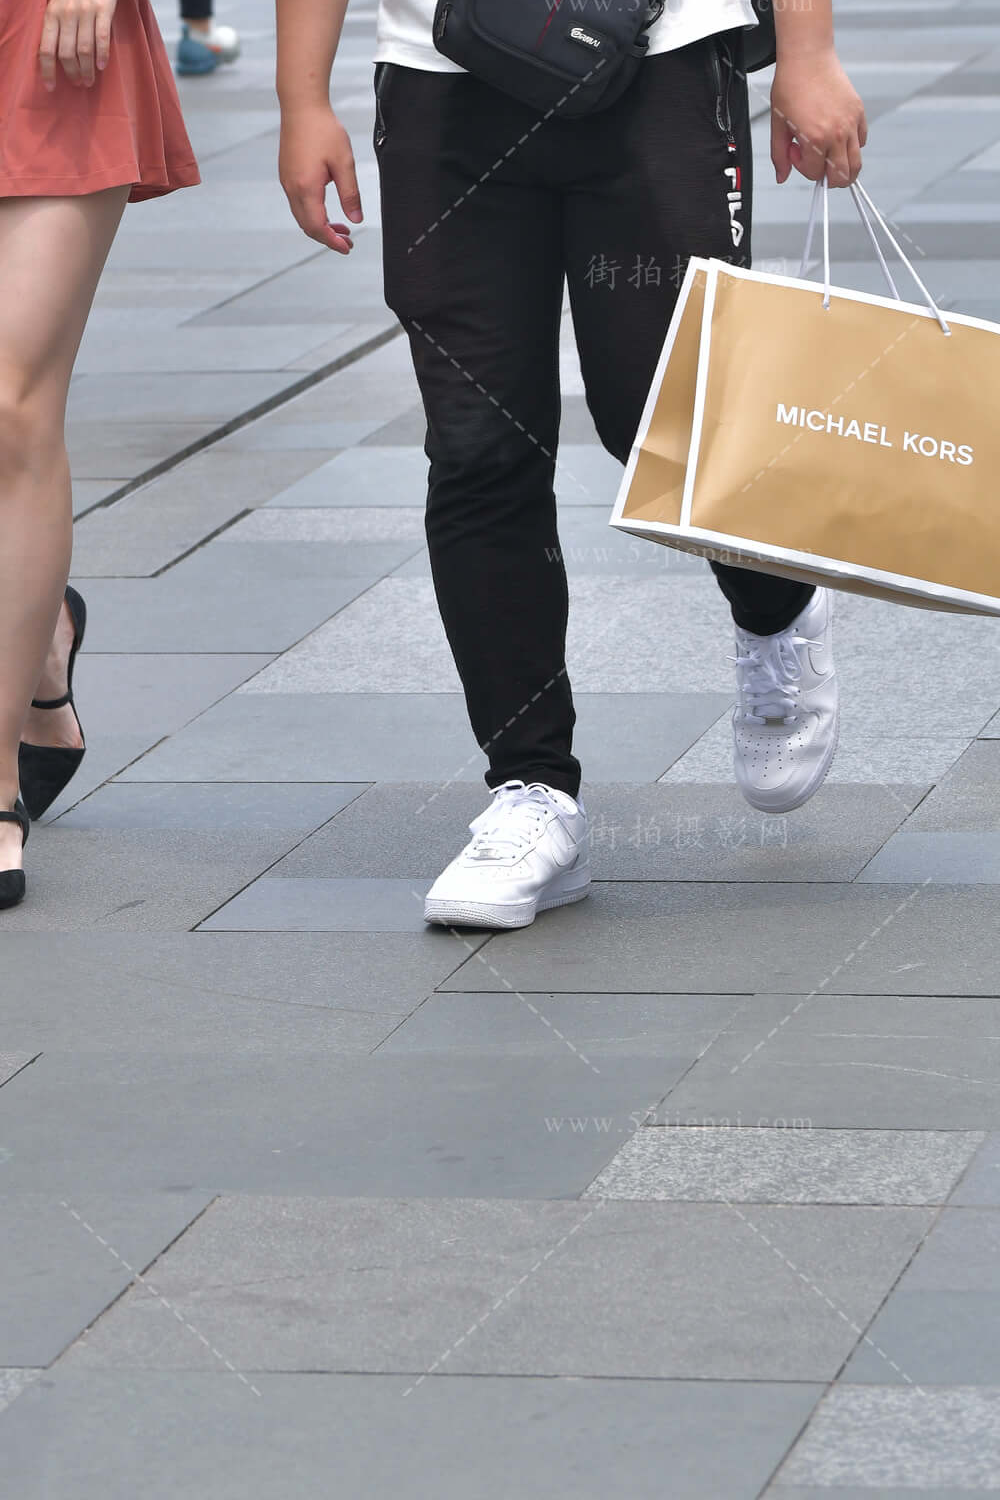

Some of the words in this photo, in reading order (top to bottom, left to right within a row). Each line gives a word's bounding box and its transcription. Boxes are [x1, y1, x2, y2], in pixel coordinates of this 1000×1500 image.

[724, 166, 744, 247] FILA
[776, 403, 893, 447] MICHAEL
[902, 431, 974, 466] KORS
